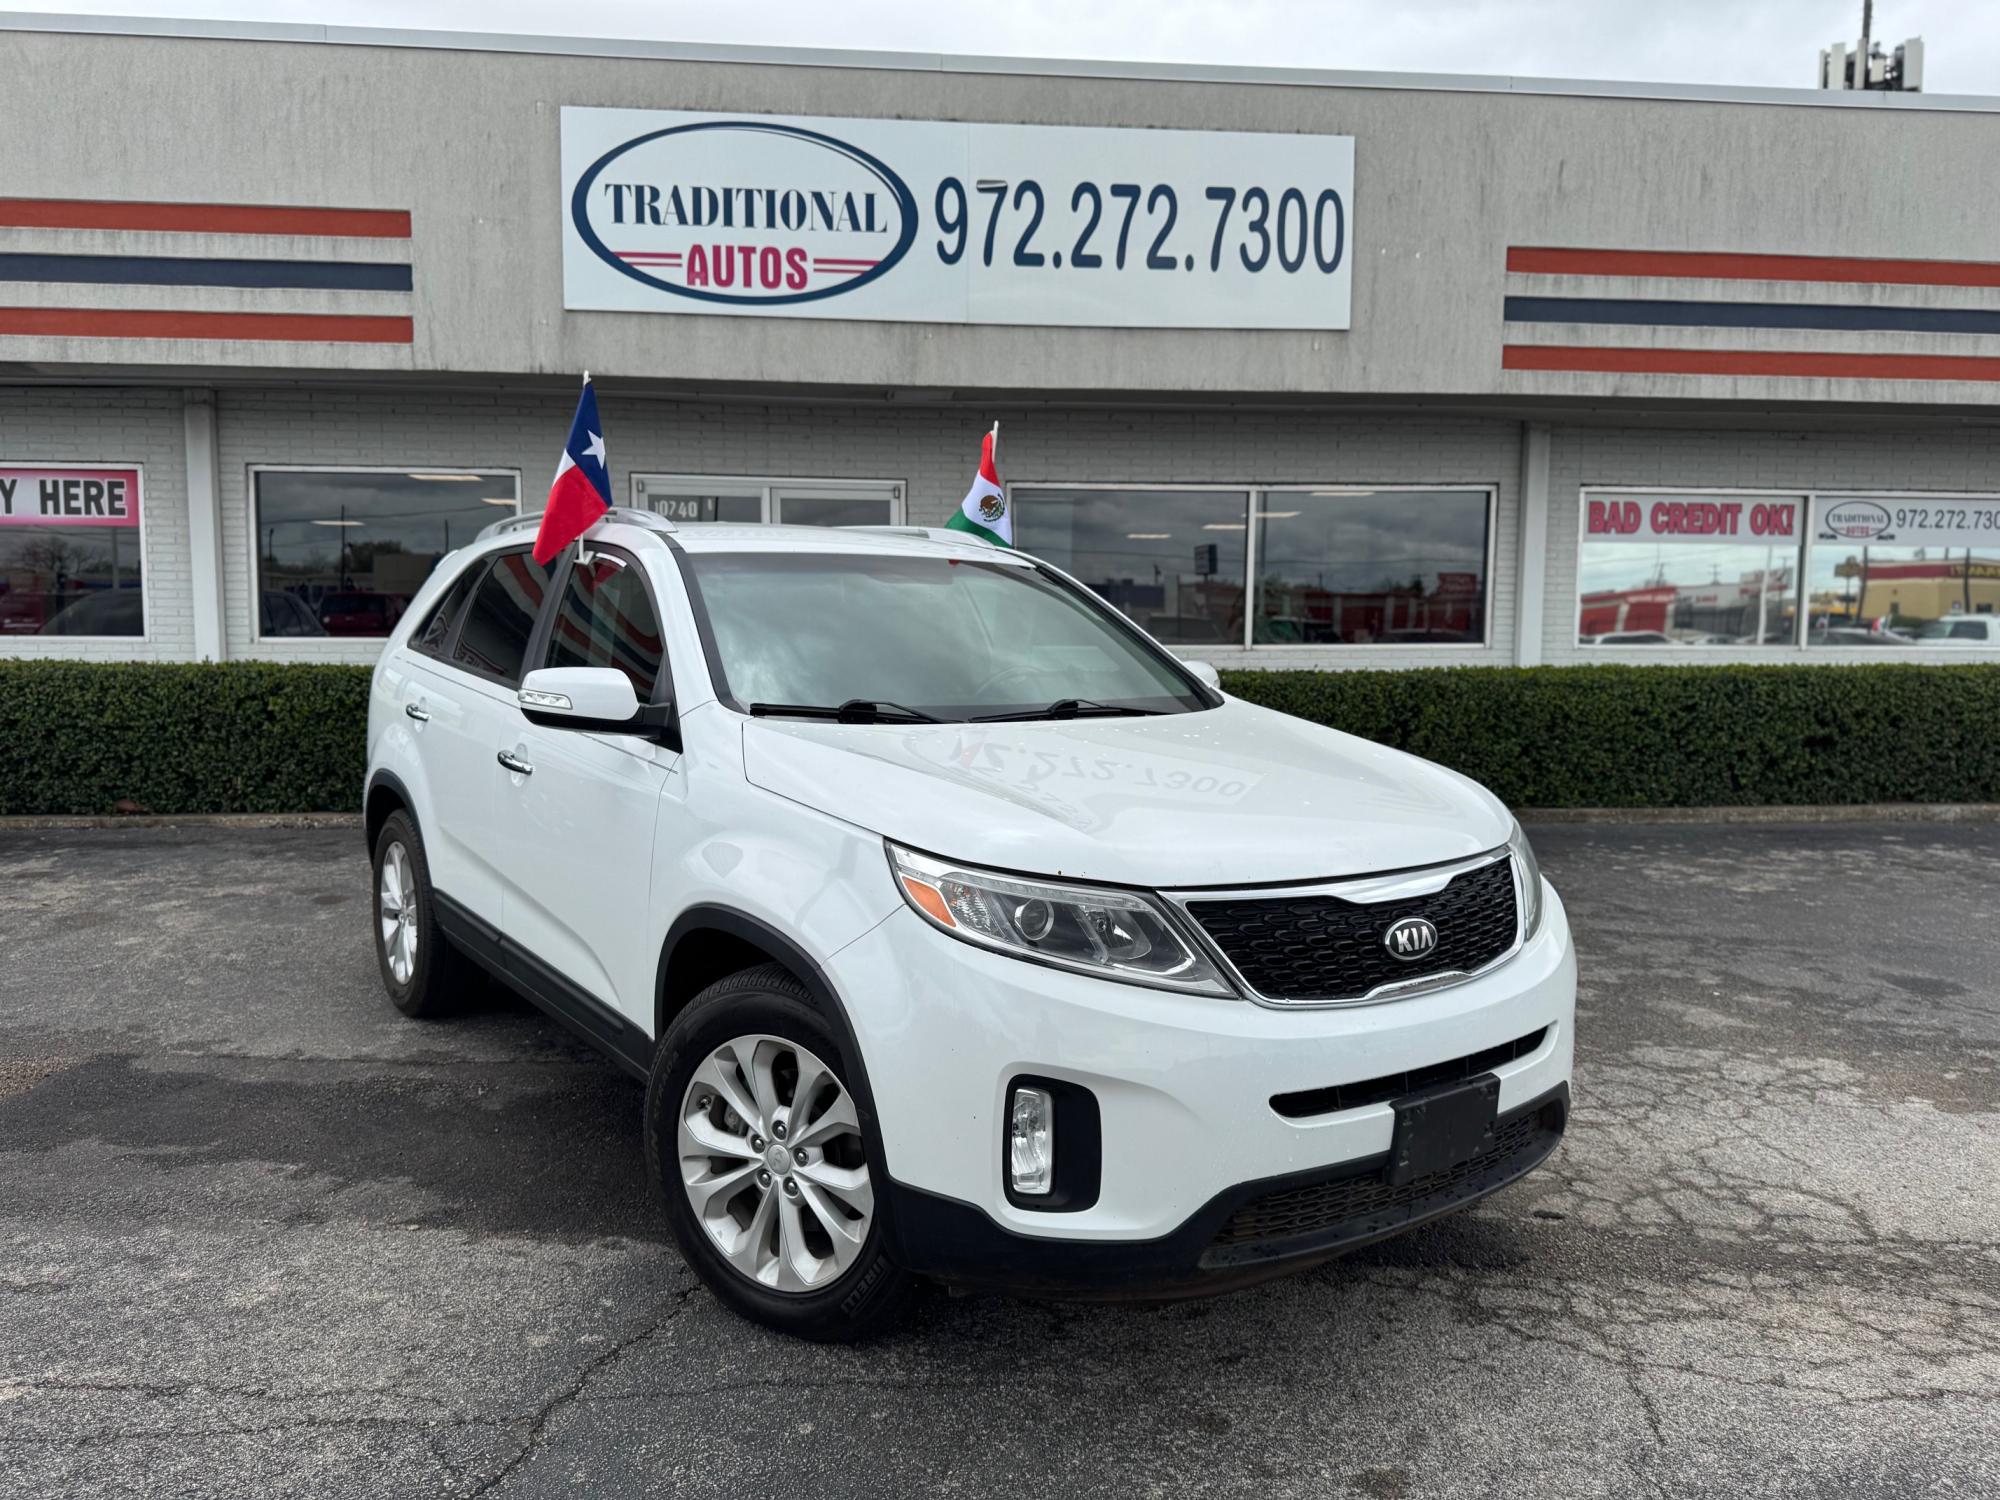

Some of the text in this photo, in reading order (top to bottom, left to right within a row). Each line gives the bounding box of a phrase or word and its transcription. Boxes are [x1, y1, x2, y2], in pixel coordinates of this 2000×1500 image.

[604, 184, 888, 233] TRADITIONAL
[935, 176, 1345, 275] 972.272.7300
[685, 244, 810, 291] AUTOS
[39, 479, 126, 516] HERE
[1588, 501, 1795, 537] BAD CREDIT OK!
[1832, 513, 1885, 524] TRADITIONAL
[1395, 925, 1433, 953] KIA
